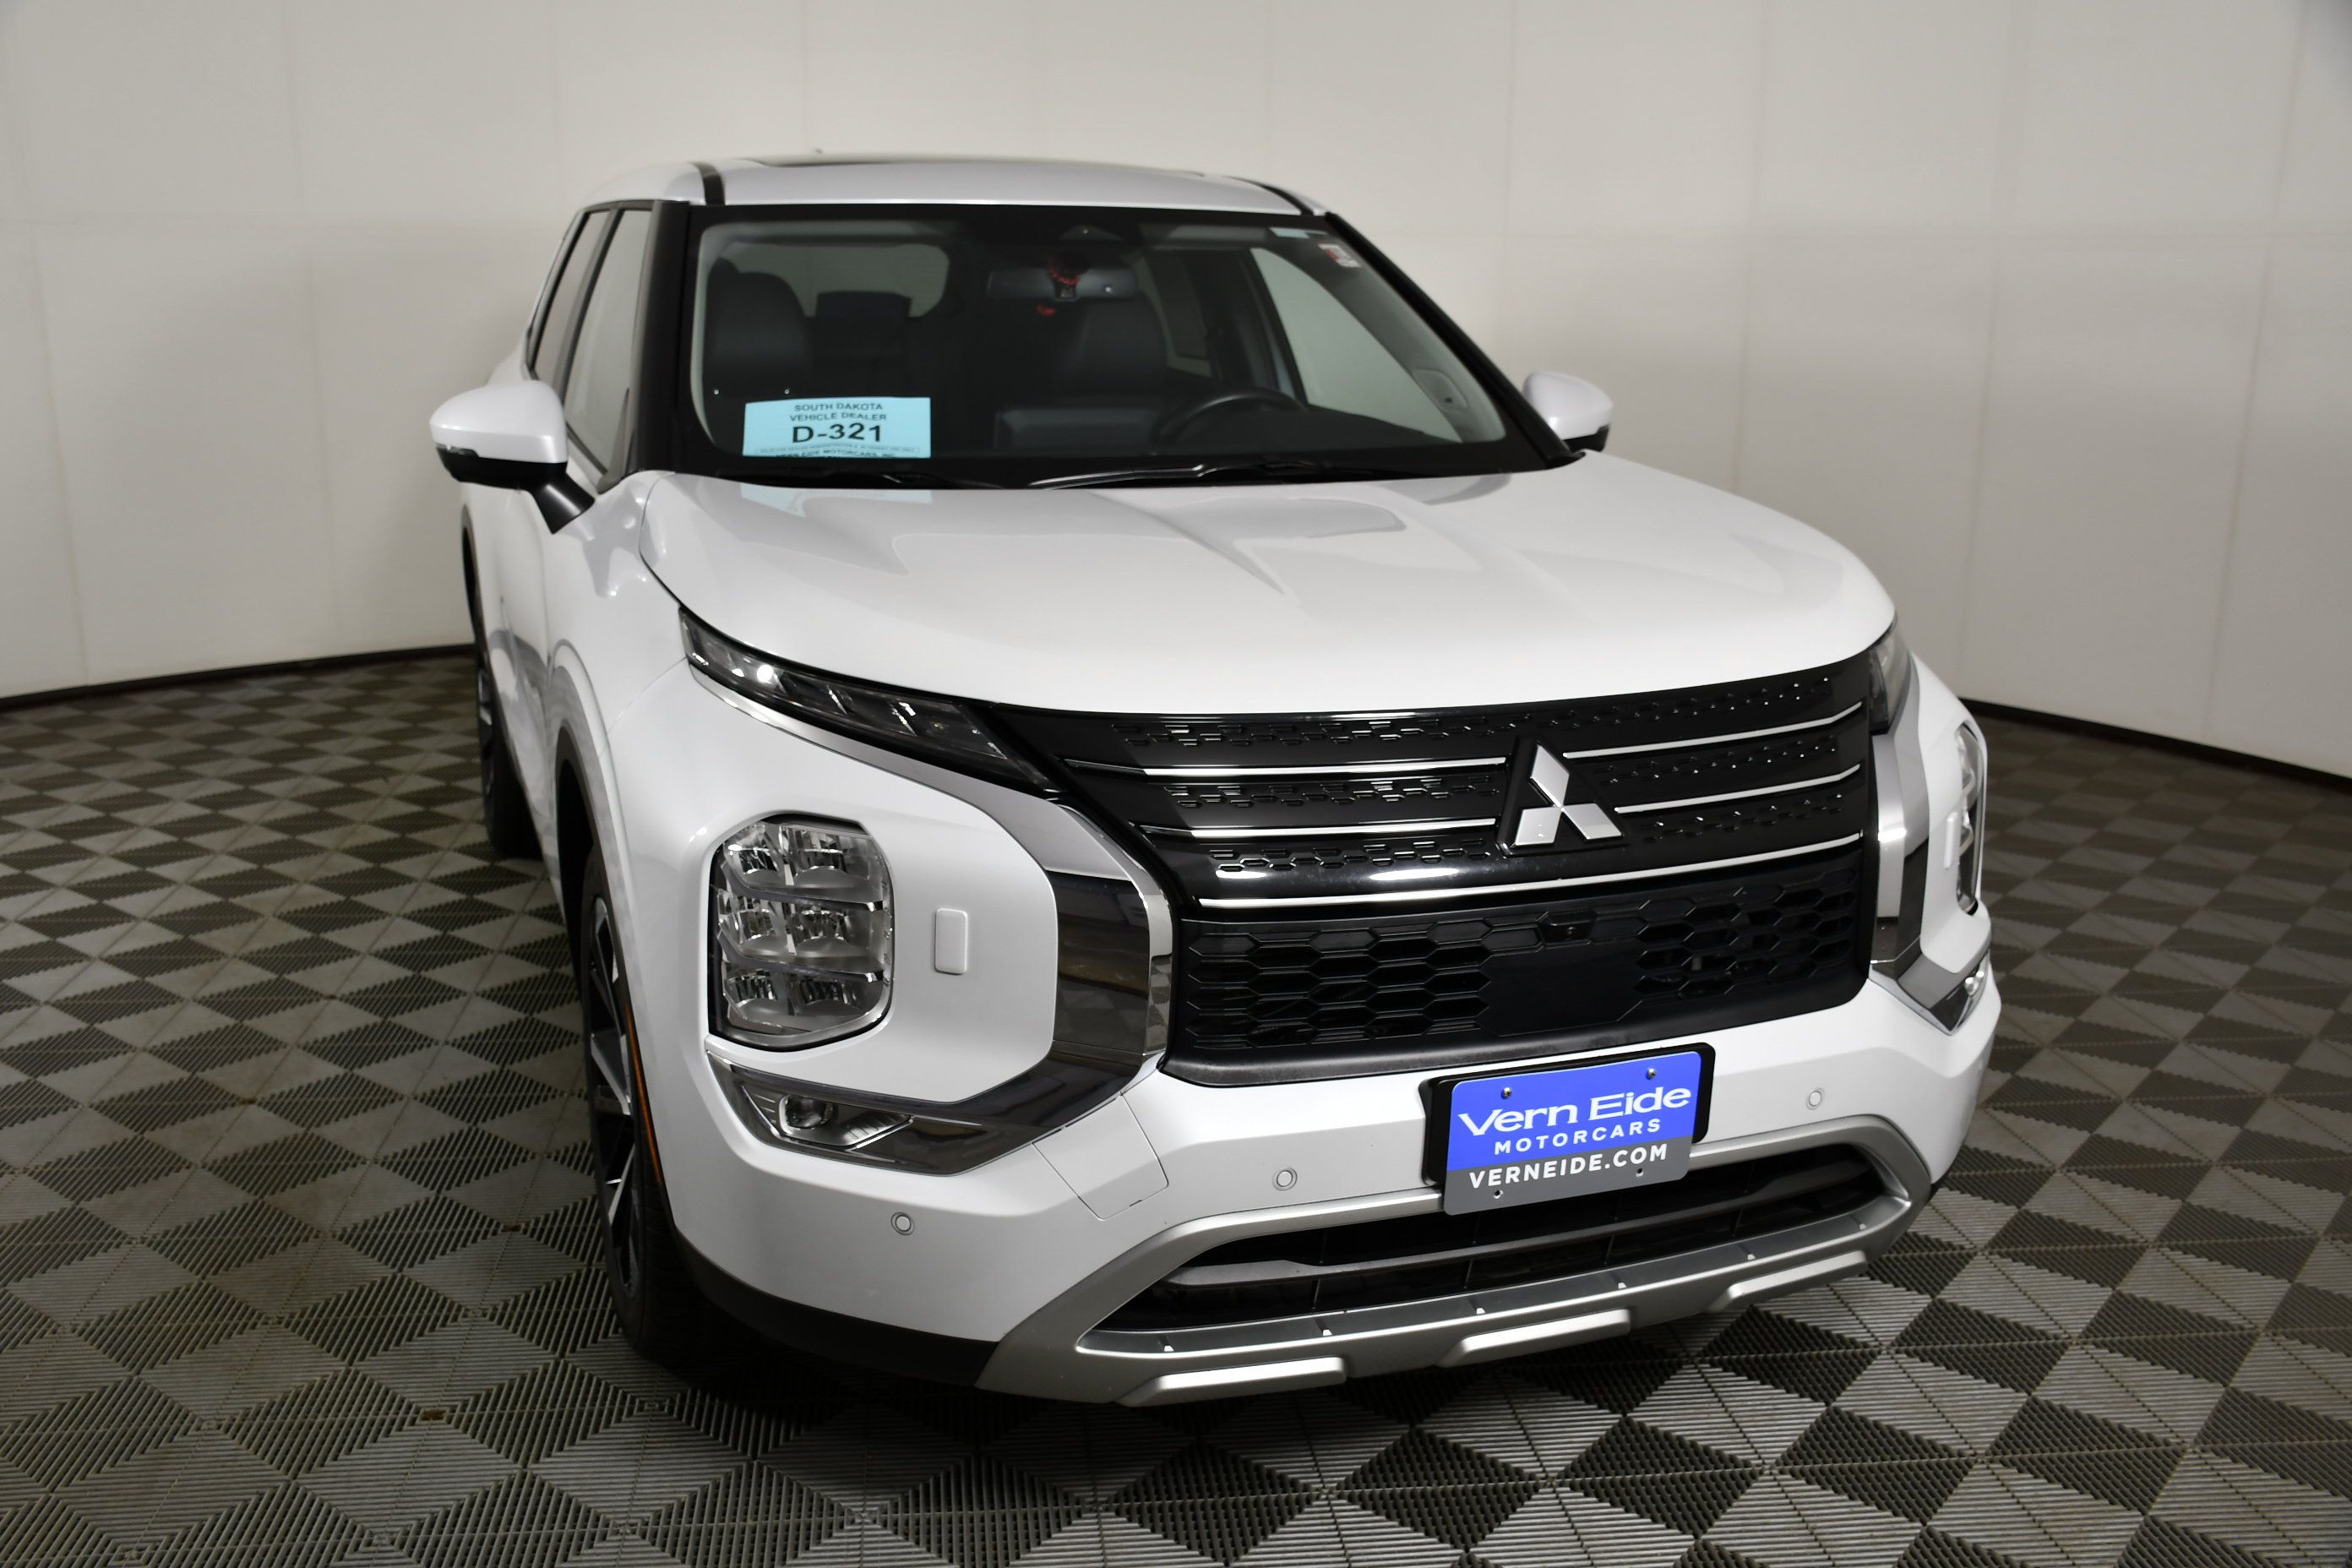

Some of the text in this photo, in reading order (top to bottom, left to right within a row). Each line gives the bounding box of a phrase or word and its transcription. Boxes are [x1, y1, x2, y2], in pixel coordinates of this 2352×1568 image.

[790, 412, 887, 422] VEHICLE DEALER
[794, 403, 883, 412] SOUTH DAKOTA
[792, 422, 880, 443] D-321
[1457, 1086, 1691, 1136] Vern Eide
[1494, 1118, 1661, 1155] MOTORCARS
[1468, 1143, 1668, 1189] VERNEIDE.COM
